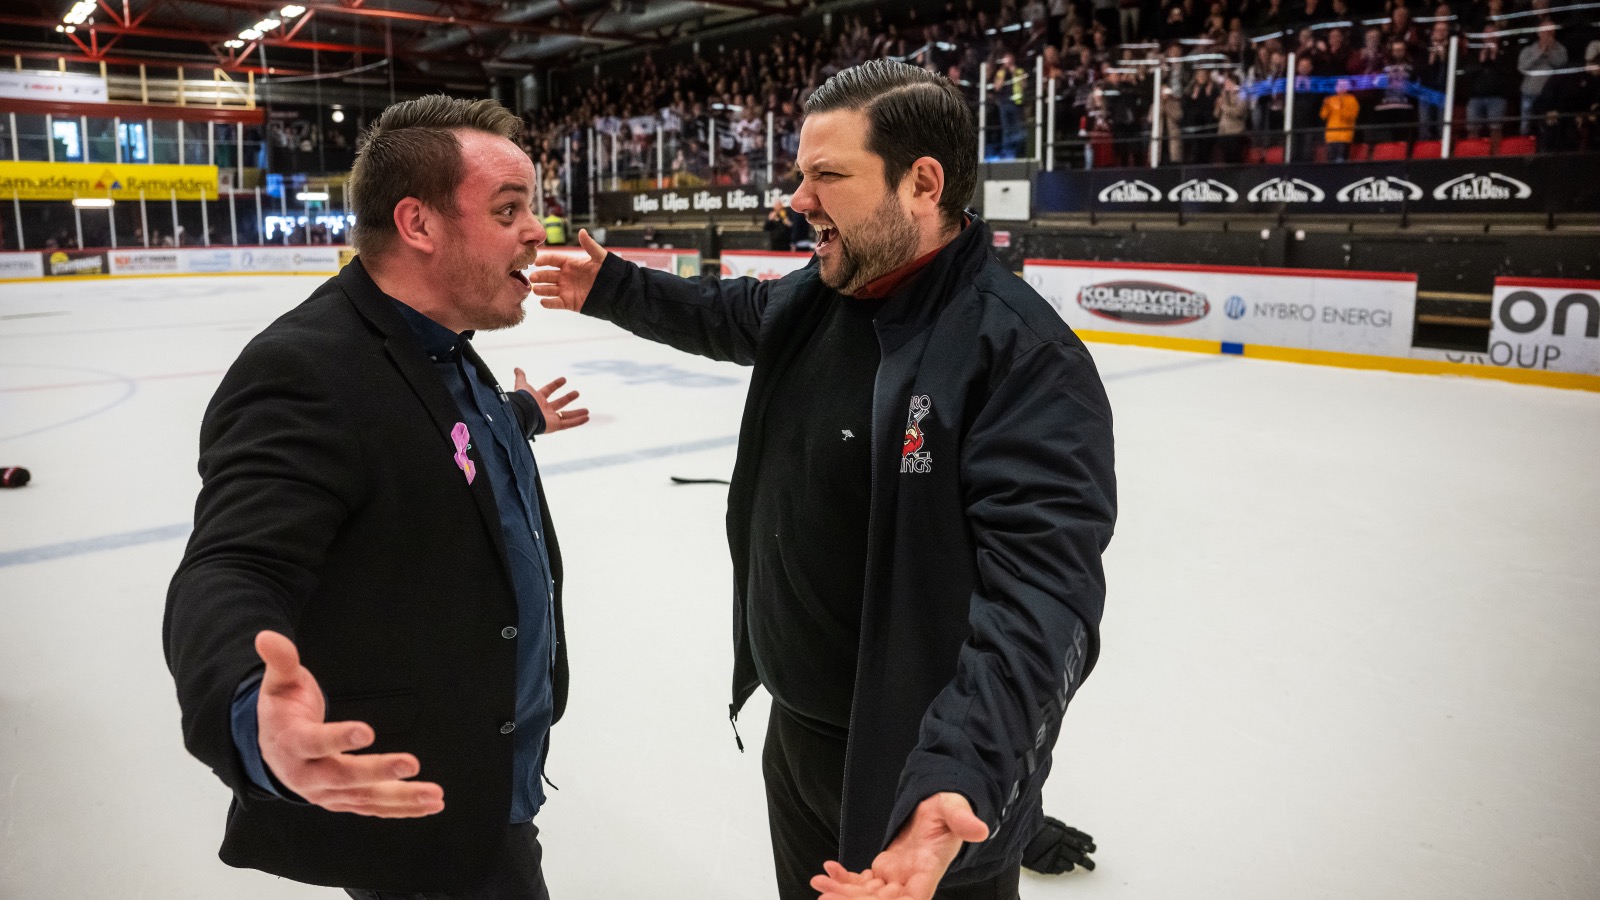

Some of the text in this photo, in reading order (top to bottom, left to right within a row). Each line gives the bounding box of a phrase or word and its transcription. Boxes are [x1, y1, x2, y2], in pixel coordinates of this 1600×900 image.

[0, 175, 90, 191] amudden
[126, 176, 214, 192] Ramudden
[1080, 286, 1207, 308] KOLSBYGDS
[1080, 300, 1207, 319] MASKINCENTER
[1253, 303, 1393, 328] NYBRO ENERGI
